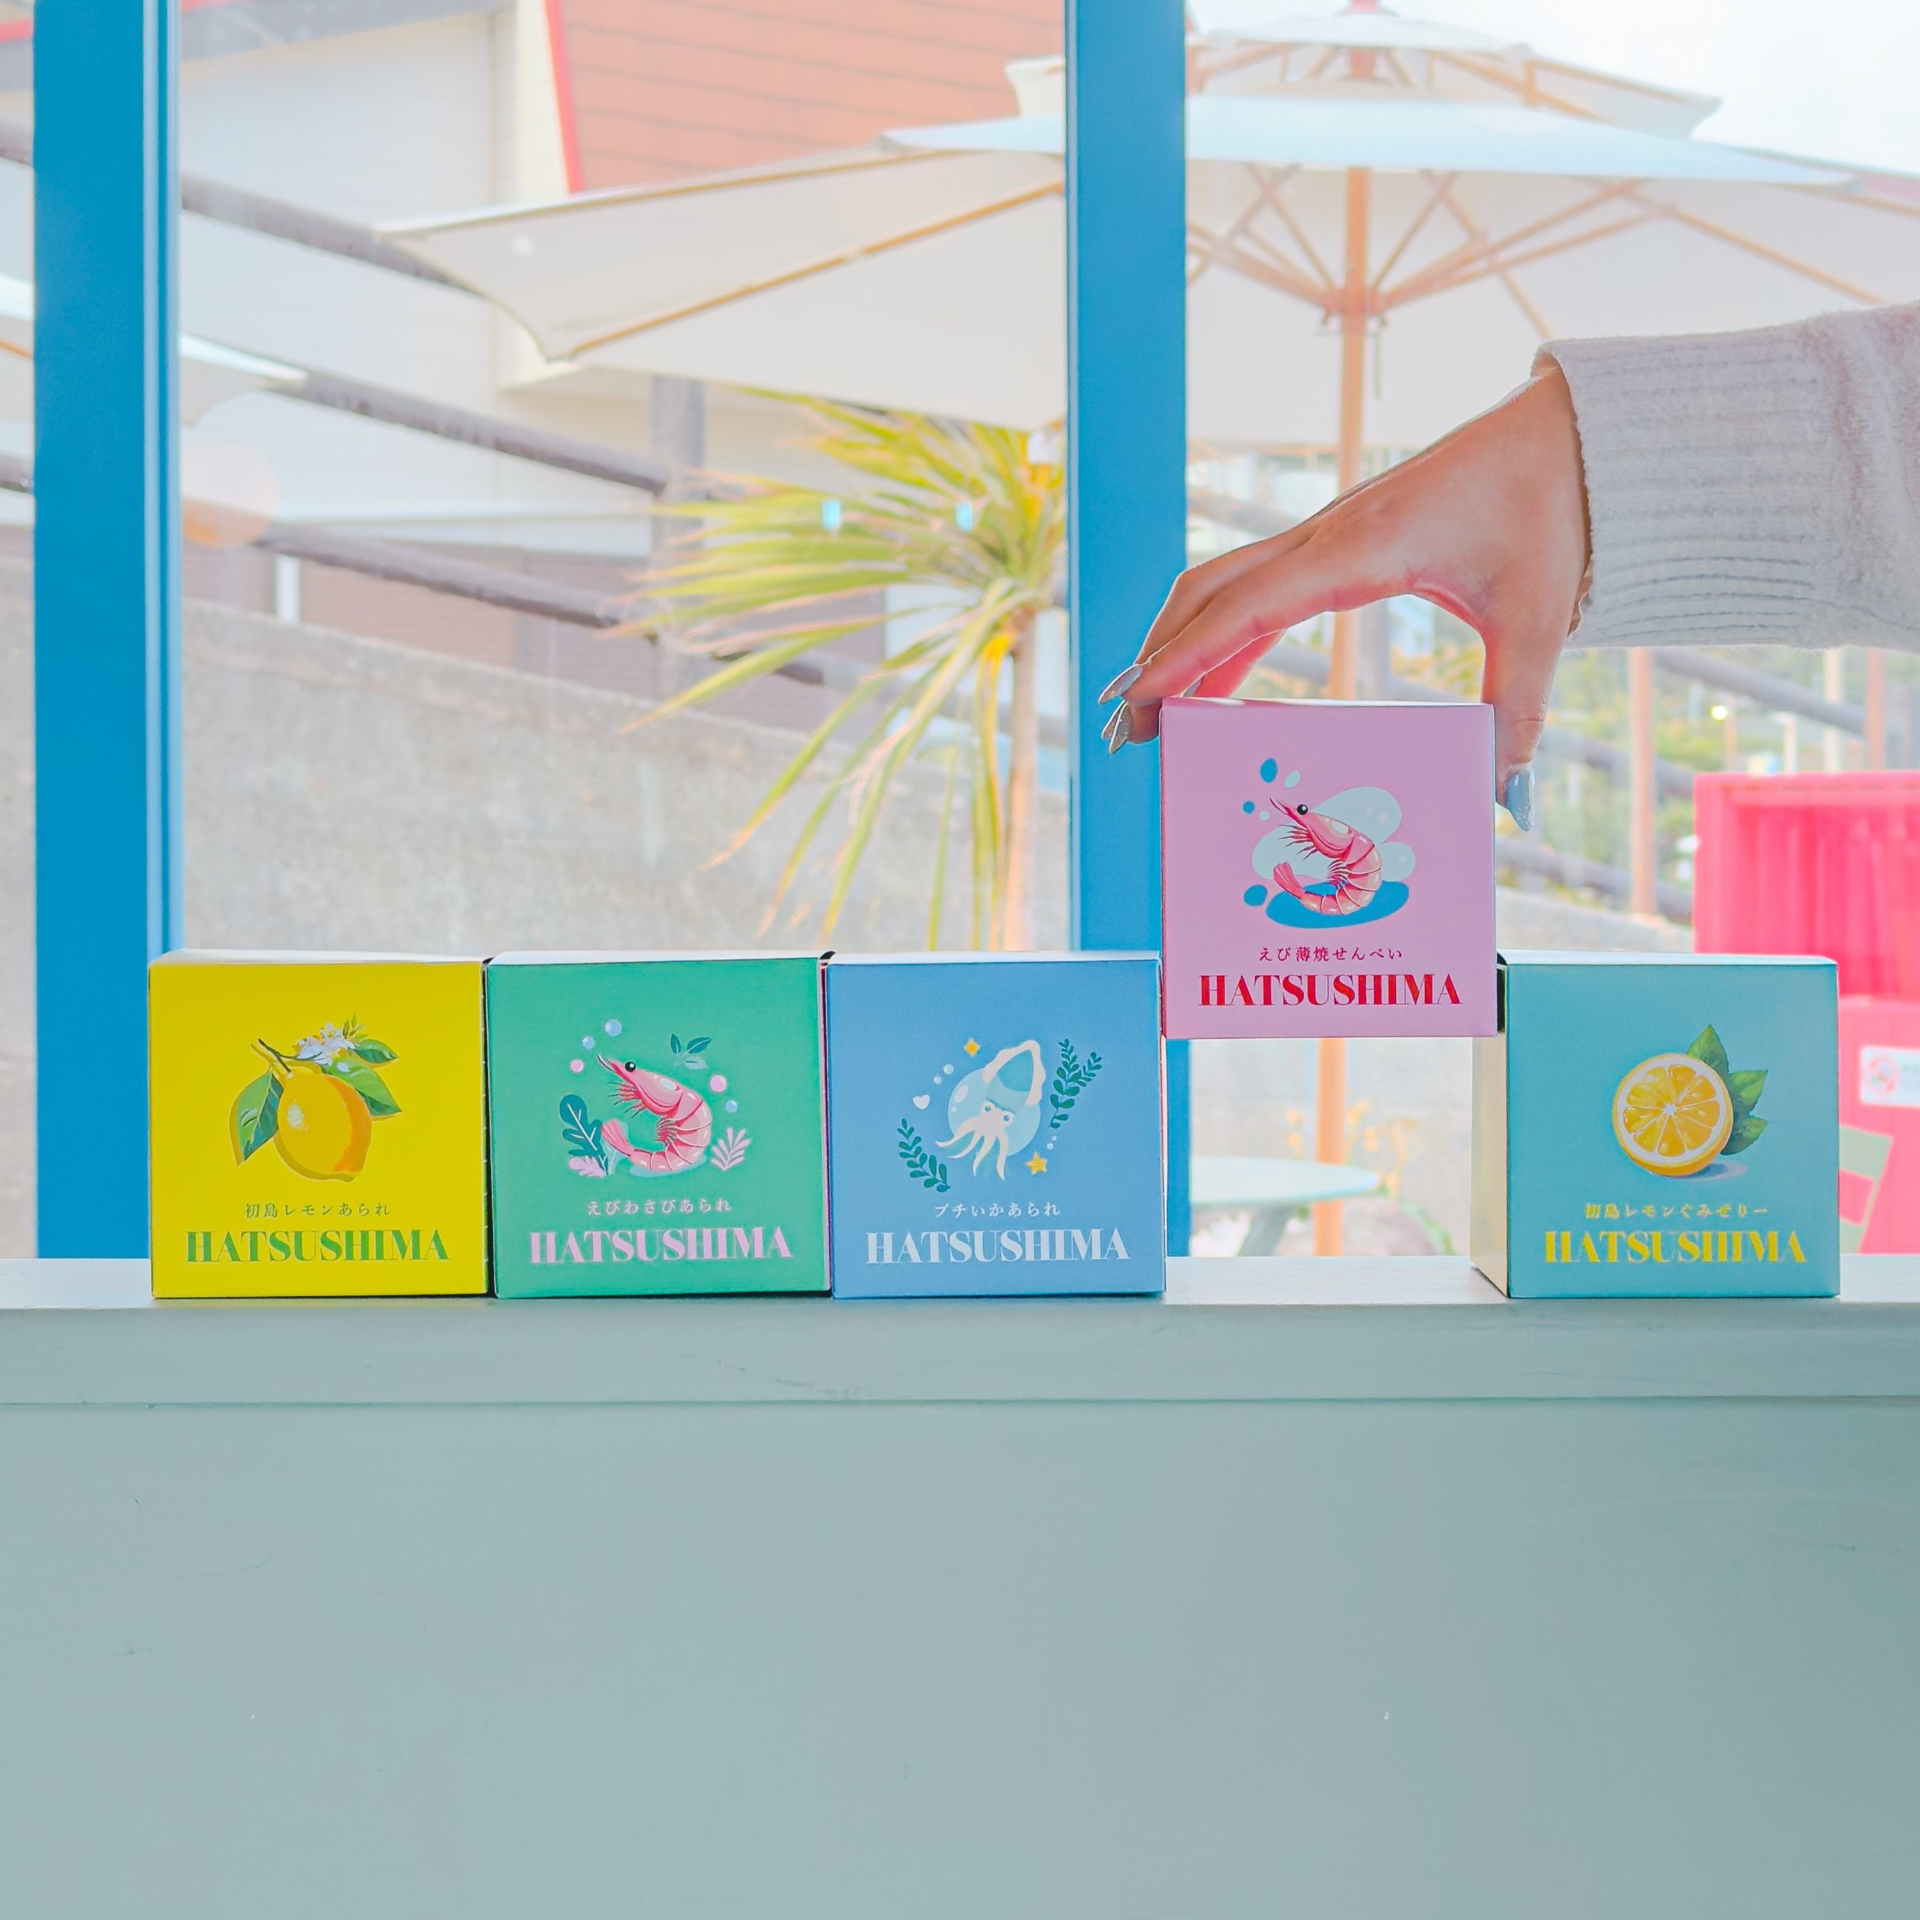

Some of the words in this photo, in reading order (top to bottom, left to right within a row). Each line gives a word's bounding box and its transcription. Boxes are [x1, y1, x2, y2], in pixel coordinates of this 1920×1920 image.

[1258, 946, 1403, 962] えび薄焼せんべい
[1198, 973, 1463, 1007] HATSUSHIMA
[244, 1202, 390, 1219] 初島レモンあられ
[587, 1198, 732, 1217] えびわさびあられ
[185, 1229, 451, 1265] HATSUSHIMA
[528, 1226, 794, 1265] HATSUSHIMA
[865, 1228, 1132, 1264] HATSUSHIMA
[1544, 1229, 1807, 1264] HATSUSHIMA
